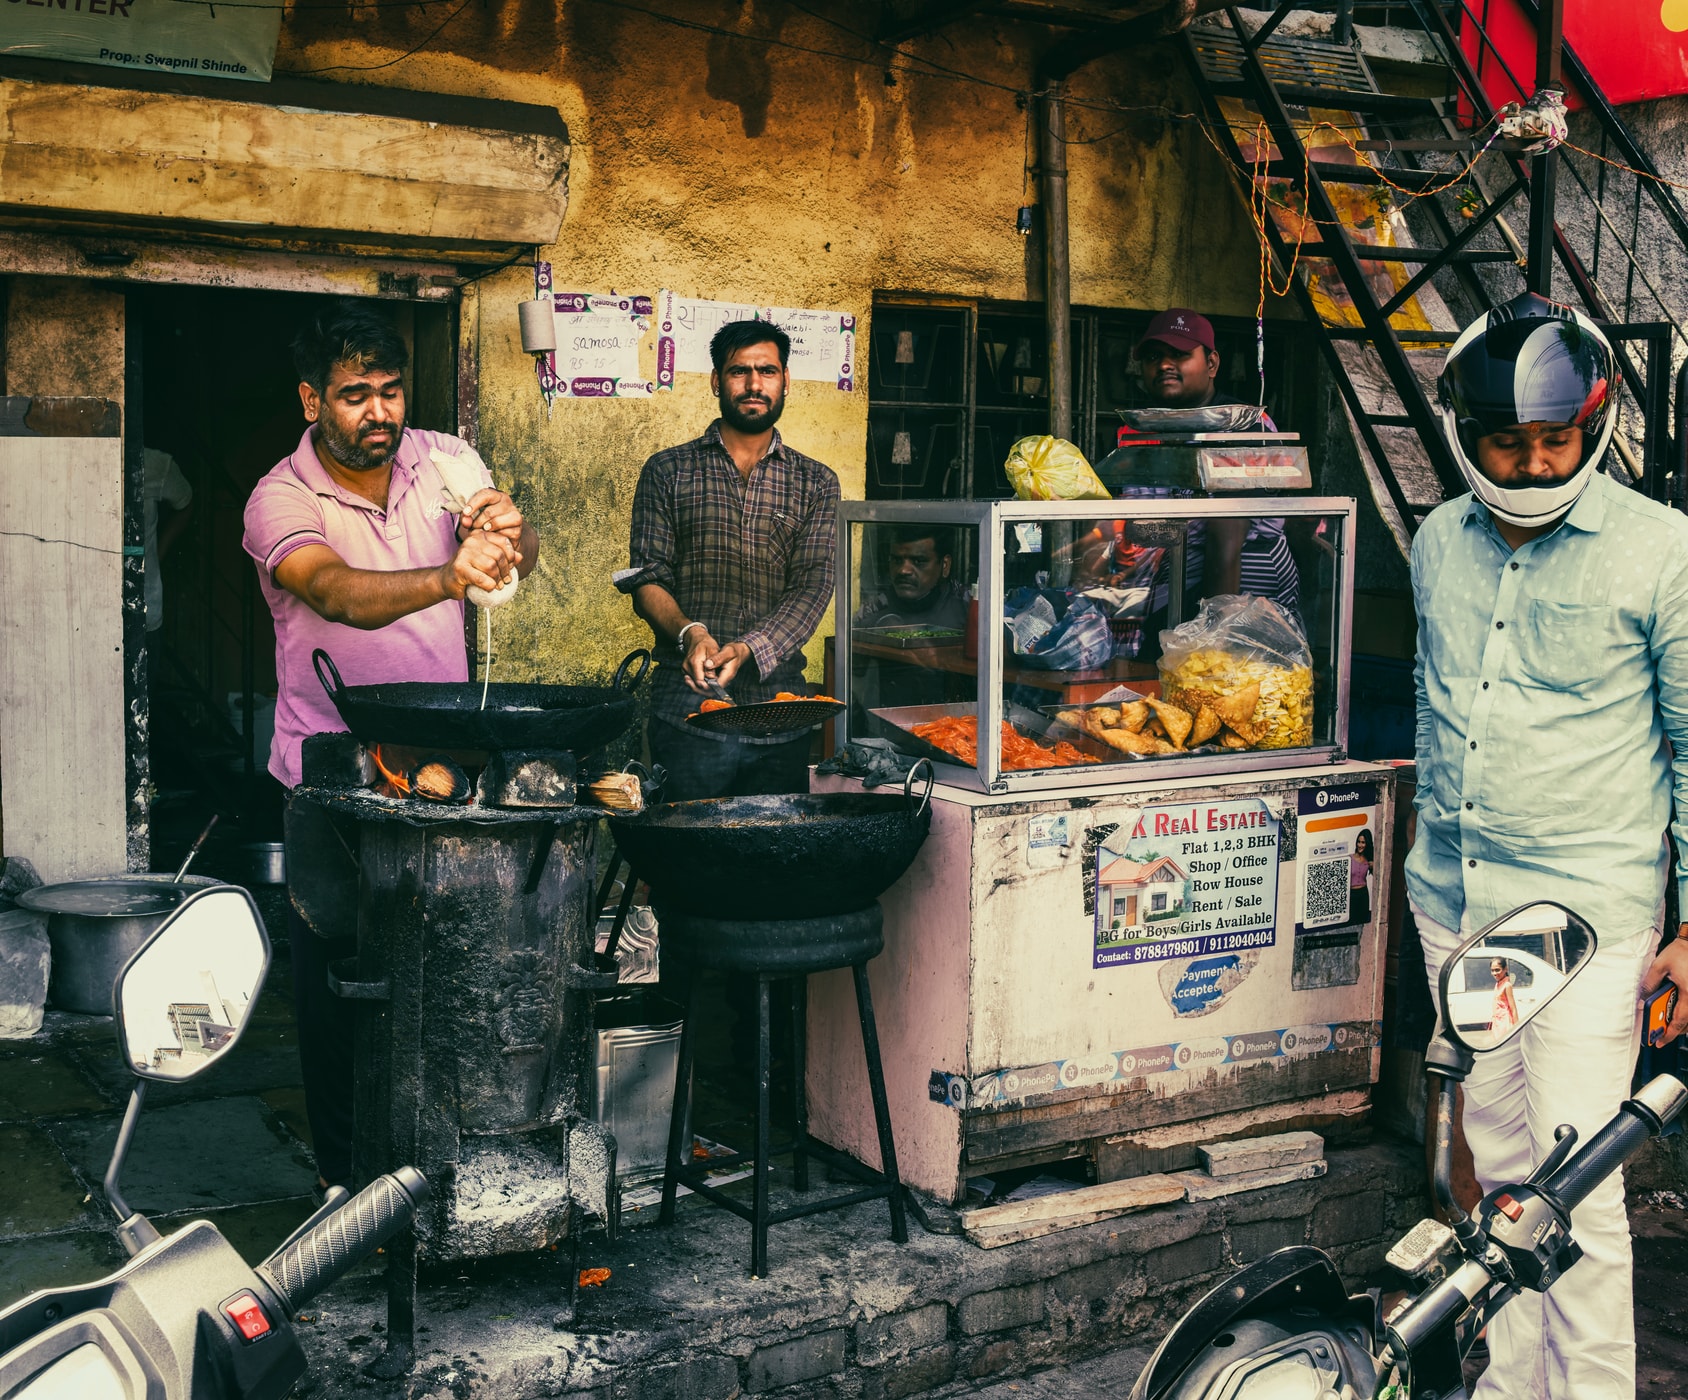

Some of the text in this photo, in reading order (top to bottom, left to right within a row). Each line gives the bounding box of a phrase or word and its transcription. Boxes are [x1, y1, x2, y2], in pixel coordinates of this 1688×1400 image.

[100, 48, 247, 74] Prop.: Swapnil Shinde
[1329, 791, 1360, 803] PhonePe
[1182, 834, 1277, 855] Flat 1,2,3 BHK
[1189, 855, 1268, 875] Shop / Office
[1192, 875, 1264, 892] Row House
[1191, 894, 1263, 913] Rent / Sale
[1100, 912, 1272, 943] PG for Boys/Girls Available
[1096, 951, 1132, 964] Contact:
[1134, 939, 1200, 961] 8788479801
[1209, 930, 1273, 951] 9112040404
[1246, 1041, 1277, 1053] PhonePe
[1298, 1034, 1328, 1047] PhonePe
[1193, 1047, 1225, 1060] PhonePe
[1138, 1055, 1170, 1069] PhonePe
[1080, 1064, 1114, 1077] PhonePe
[1021, 1073, 1056, 1087] PhonePe
